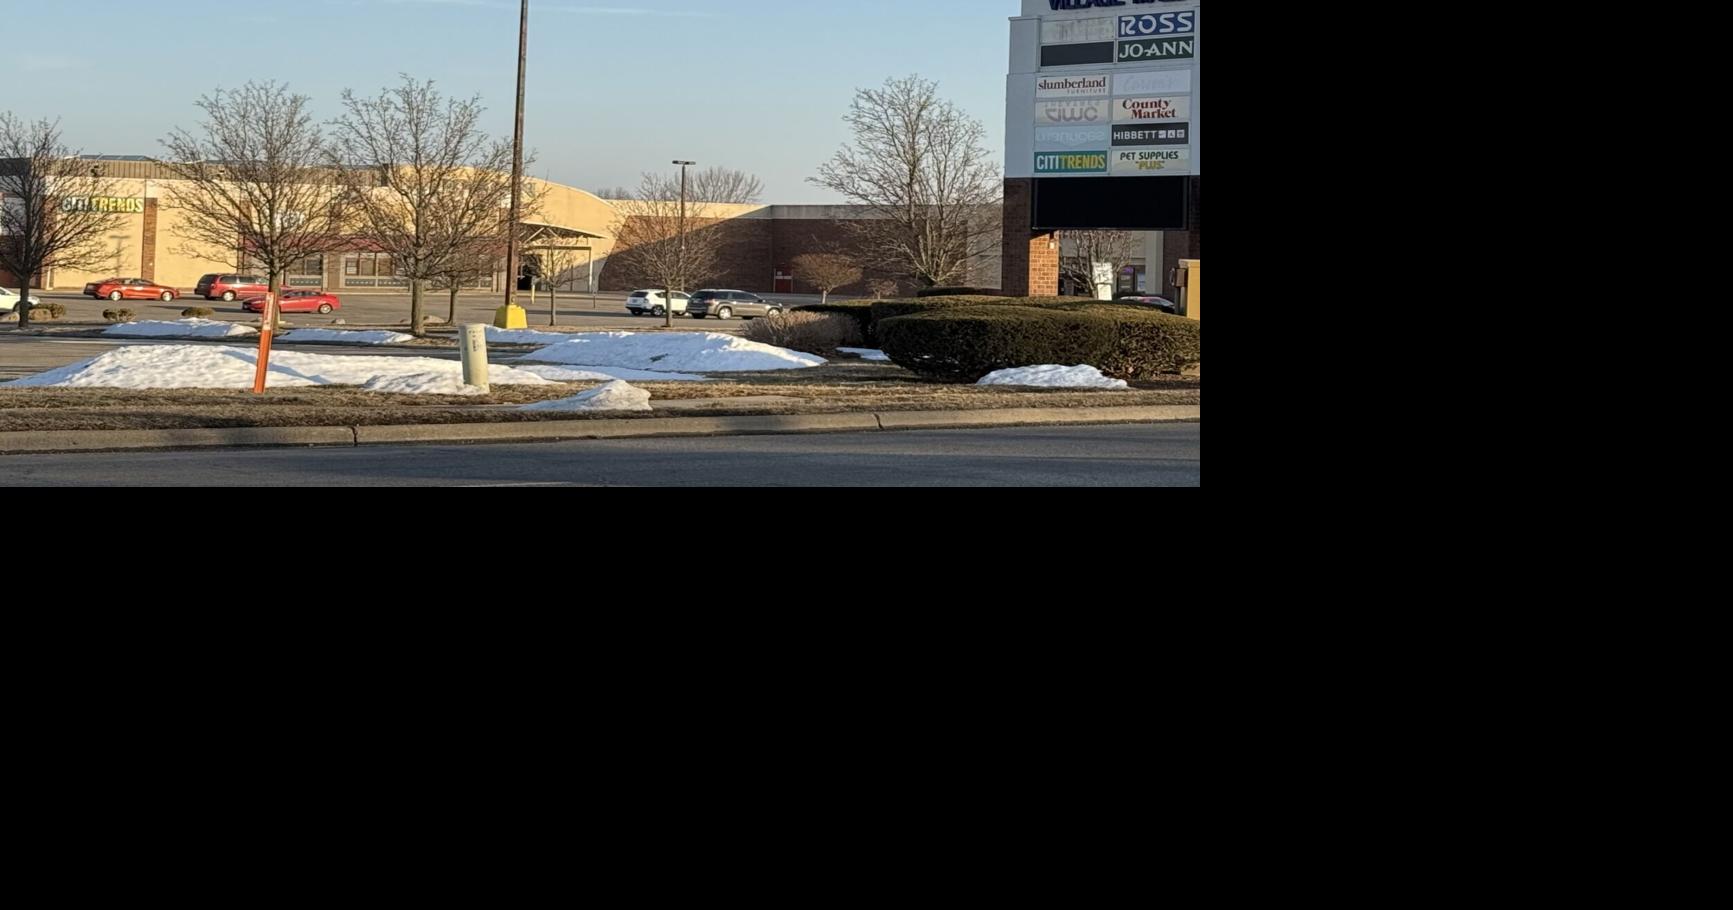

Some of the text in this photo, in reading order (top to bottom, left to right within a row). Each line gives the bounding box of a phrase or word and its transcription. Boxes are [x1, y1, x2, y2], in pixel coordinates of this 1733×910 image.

[1121, 12, 1193, 35] ROSS
[1119, 41, 1193, 58] JO-ANN
[1038, 76, 1106, 90] slumberland
[1122, 98, 1169, 110] County
[1131, 108, 1176, 119] Market
[1113, 130, 1157, 140] HIBBETT
[1120, 151, 1179, 160] PET SUPPLIES
